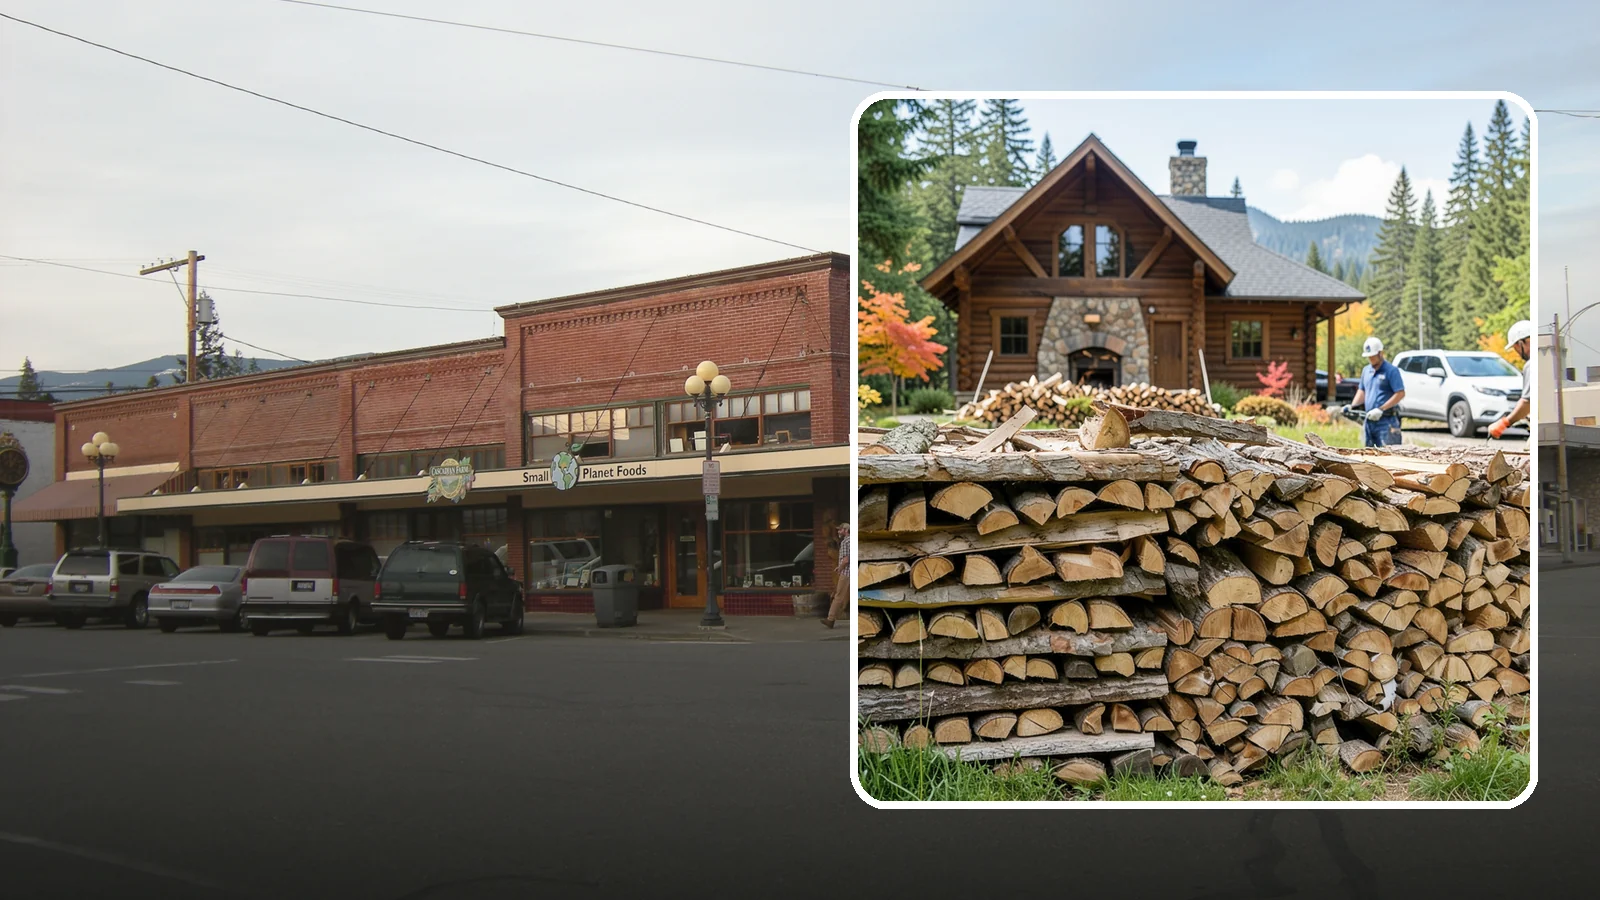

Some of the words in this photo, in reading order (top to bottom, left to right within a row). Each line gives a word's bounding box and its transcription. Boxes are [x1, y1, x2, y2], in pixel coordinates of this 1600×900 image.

[523, 471, 549, 483] Small
[583, 467, 614, 479] Planet
[617, 464, 647, 477] Foods
